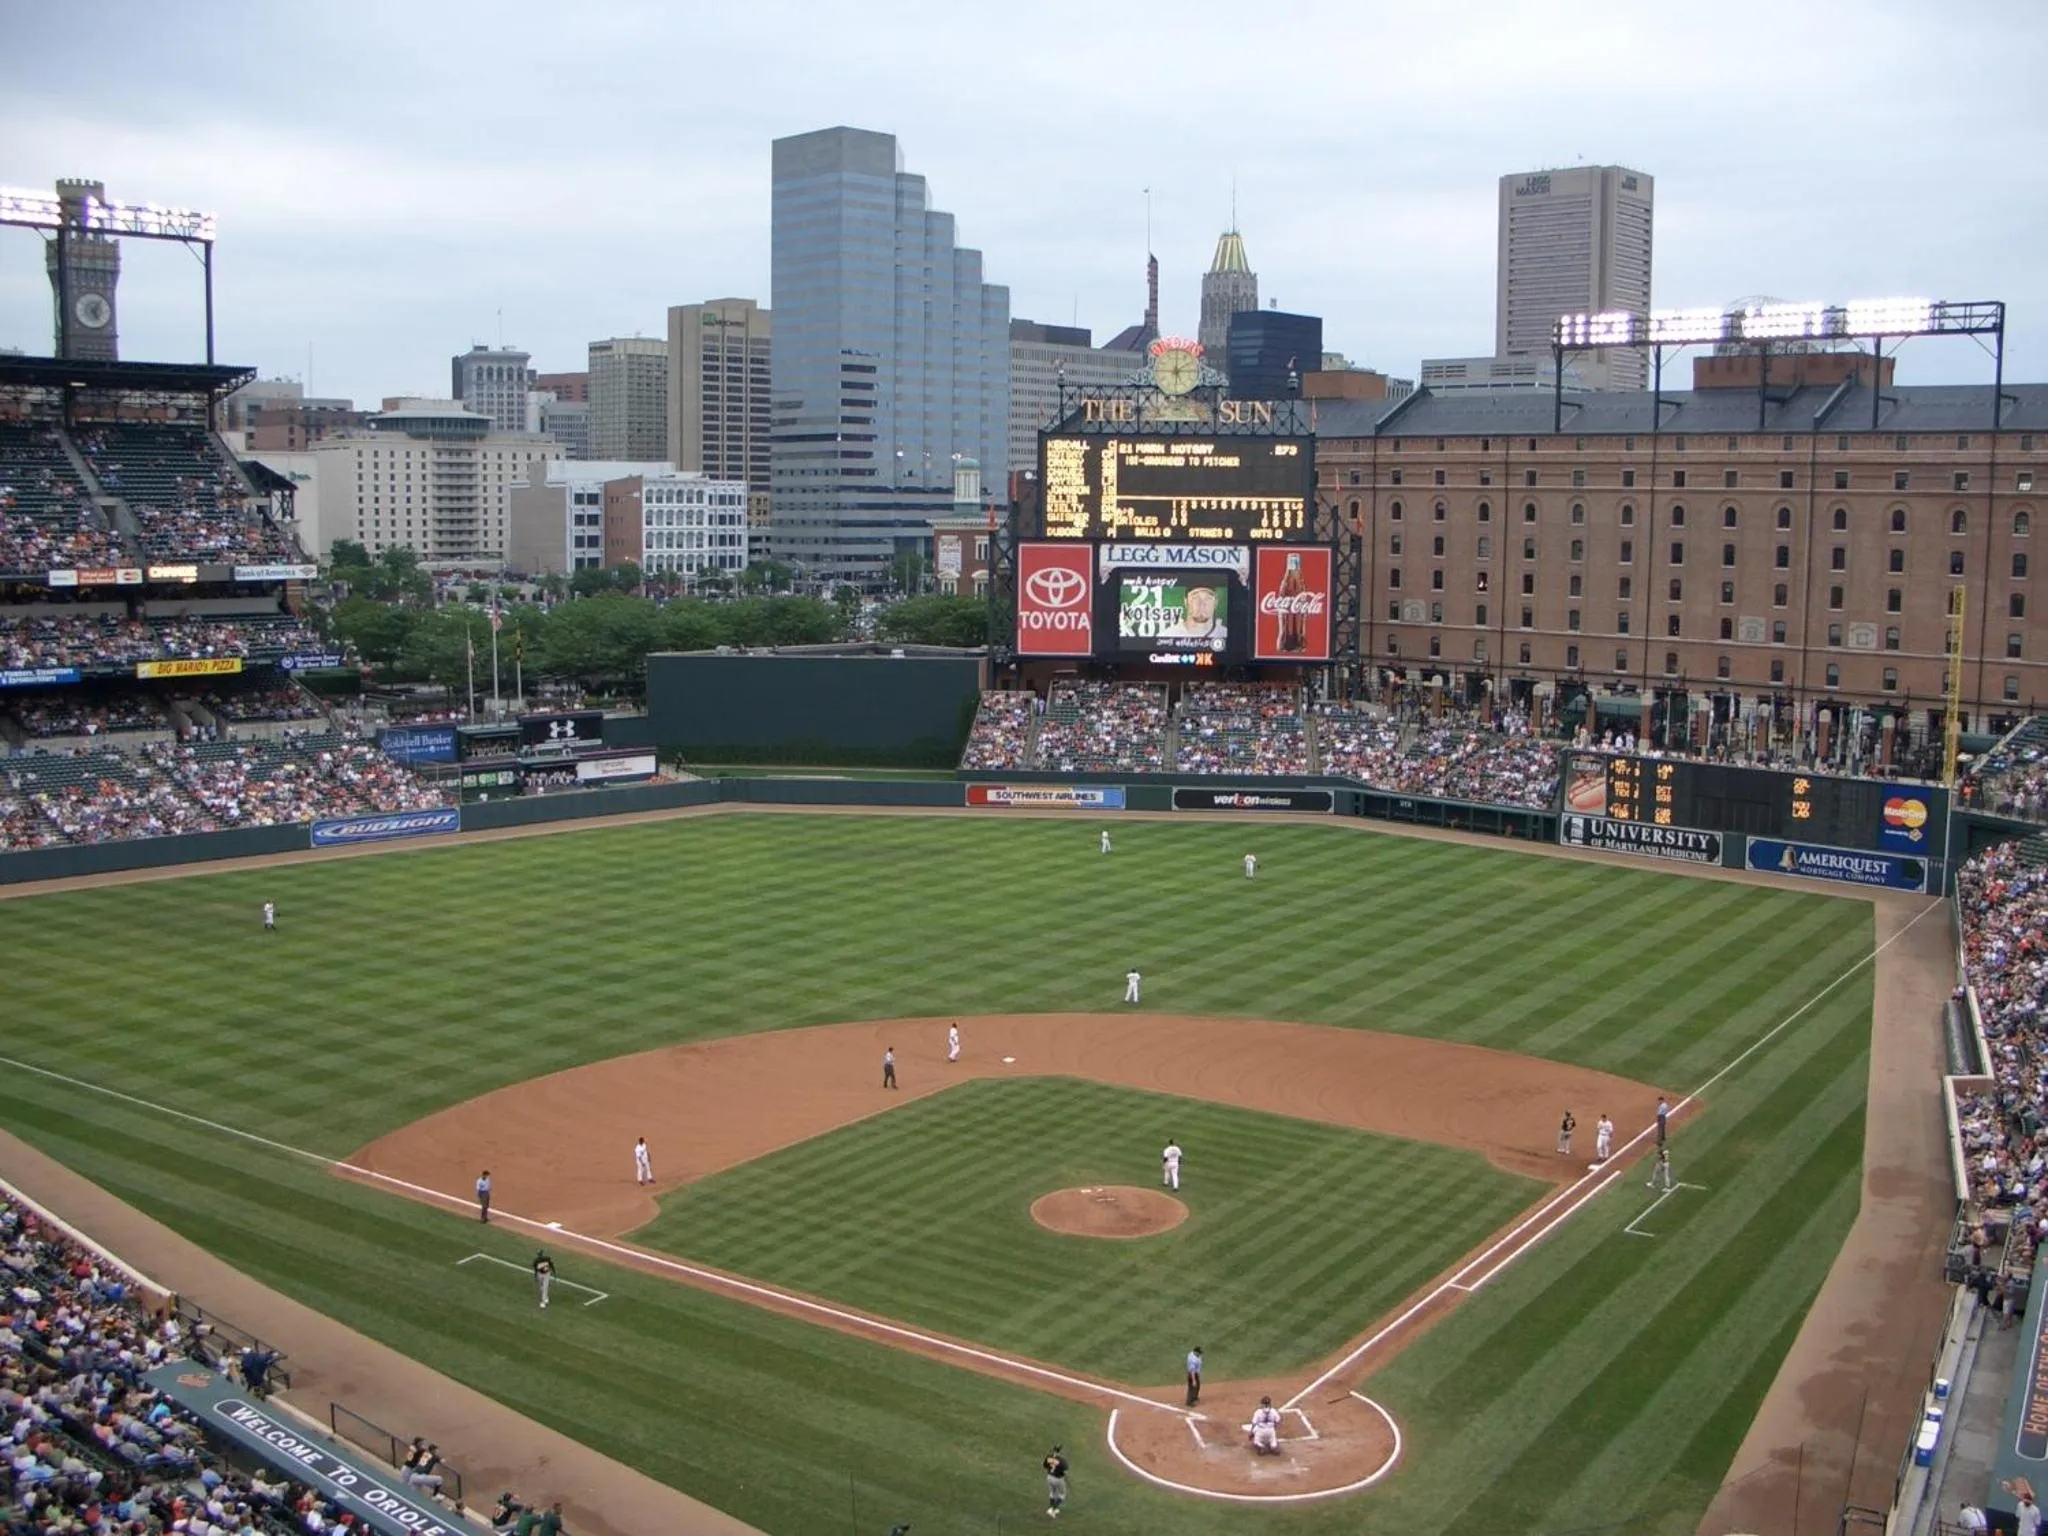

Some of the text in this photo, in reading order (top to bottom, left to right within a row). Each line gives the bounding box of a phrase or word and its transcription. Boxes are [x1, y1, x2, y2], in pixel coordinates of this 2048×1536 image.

[1082, 399, 1273, 424] THE SUN
[1189, 456, 1200, 465] TO
[1203, 457, 1240, 467] PITCHER
[1115, 516, 1158, 526] ORIOLES
[1135, 527, 1171, 537] BALLS 0
[1189, 528, 1233, 538] STRIKES 0
[1250, 528, 1283, 539] OUTS 0
[1108, 548, 1241, 564] LEGG MASON
[265, 567, 296, 576] America
[1131, 586, 1162, 607] 21
[1020, 611, 1091, 630] TOYOTA
[1121, 603, 1183, 625] kotsay
[158, 663, 172, 674] BIG
[211, 660, 235, 671] PIZZA
[996, 791, 1096, 801] SOUTHWEST AIRLINES
[1214, 793, 1260, 807] verizon
[1883, 806, 1926, 821] MasterCard
[339, 814, 456, 834] BUD LIGHT
[1591, 820, 1710, 849] UNIVERSITY
[1591, 838, 1708, 861] OF MARYLAND MEDICINE
[1799, 851, 1892, 875] AMERIQUEST
[1800, 866, 1887, 884] MORTGAGE COMPANY
[2025, 1394, 2048, 1435] HOME
[230, 1406, 447, 1536] WELCOME TO ORIOLE
